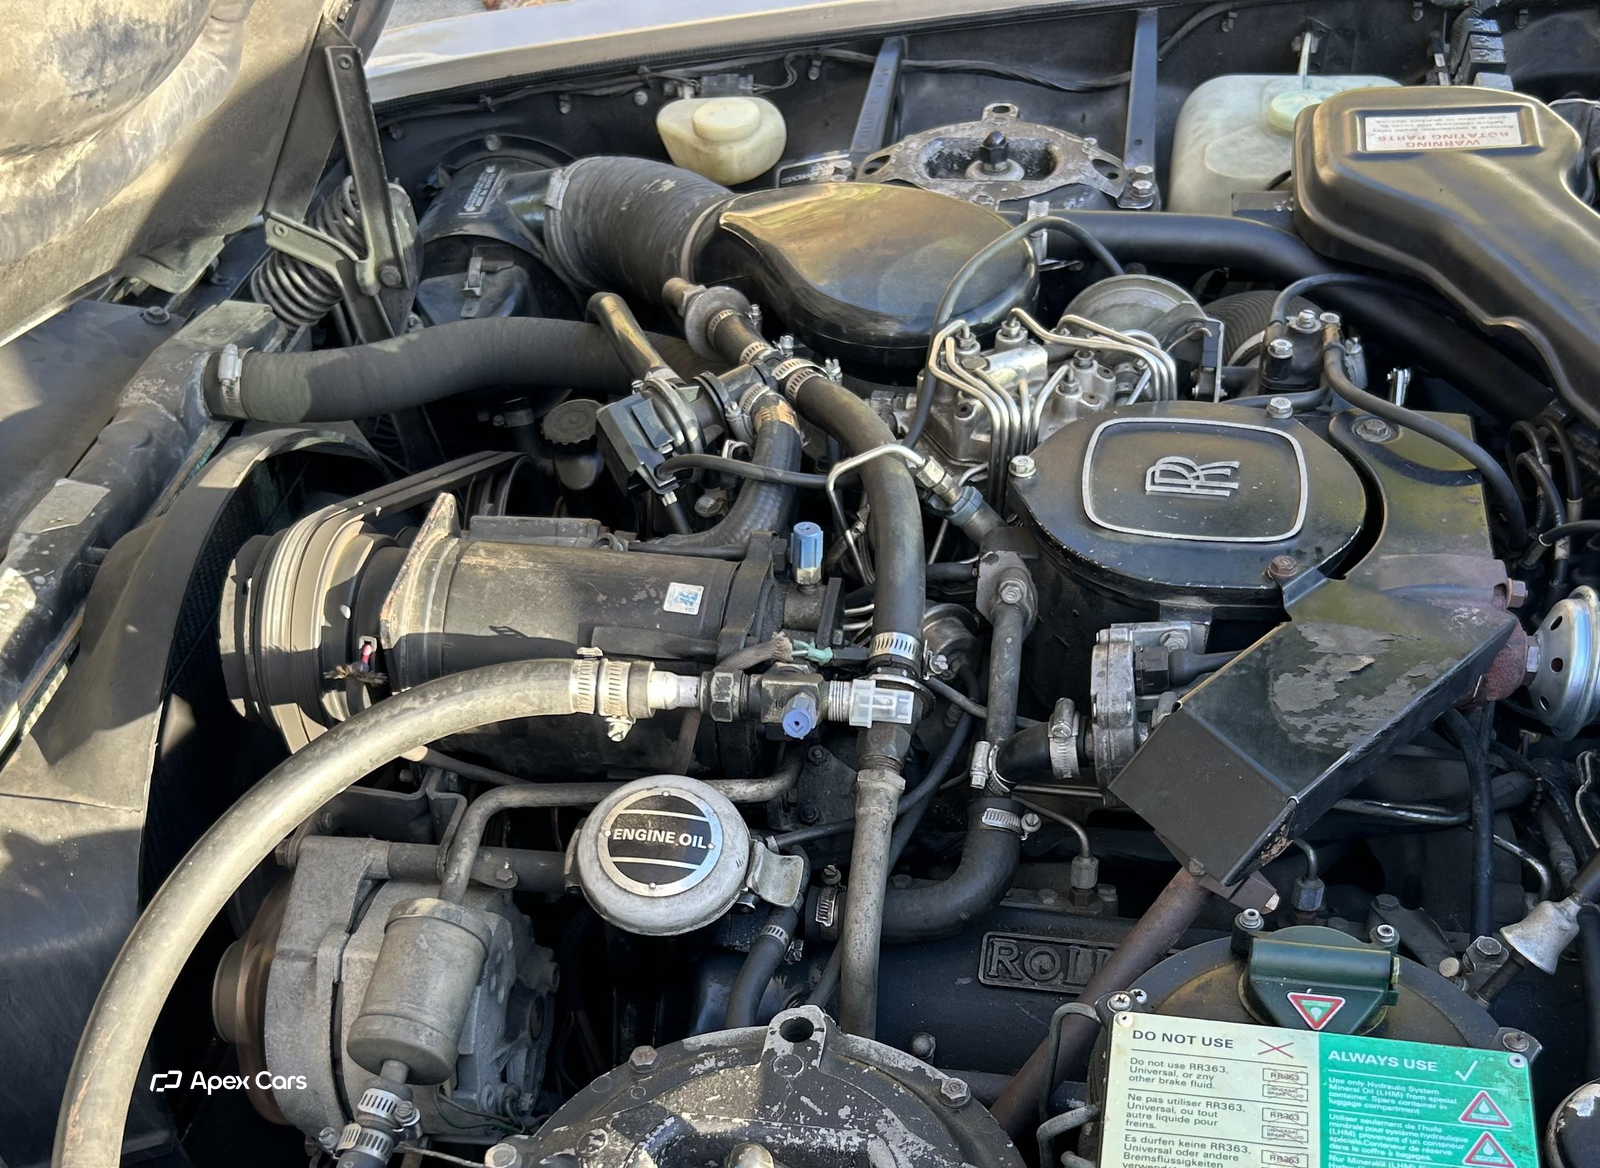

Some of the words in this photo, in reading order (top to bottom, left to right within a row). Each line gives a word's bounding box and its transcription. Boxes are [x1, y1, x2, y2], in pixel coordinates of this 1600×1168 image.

[1378, 134, 1428, 142] PARTS
[1431, 132, 1508, 140] ROTATING
[1406, 139, 1480, 148] WARNING
[612, 828, 676, 844] ENGINE
[679, 834, 707, 849] OIL
[1132, 1030, 1156, 1040] DO
[1162, 1033, 1197, 1045] NOT
[1202, 1037, 1234, 1049] USE
[1130, 1057, 1144, 1065] Do
[1148, 1059, 1164, 1067] not
[1328, 1050, 1399, 1068] ALWAYS
[1403, 1058, 1437, 1072] USE
[1129, 1075, 1155, 1083] other
[1159, 1077, 1186, 1087] brake
[1190, 1079, 1215, 1089] fluid.
[1196, 1073, 1214, 1081] any
[1348, 1078, 1364, 1086] only
[1368, 1081, 1406, 1091] Hydraulic
[1408, 1086, 1439, 1095] System
[1128, 1093, 1142, 1101] Ne
[1167, 1098, 1201, 1107] utiliser
[1329, 1084, 1359, 1093] Mineral
[1376, 1089, 1403, 1099] (LHM)
[1428, 1096, 1457, 1104] special
[1329, 1098, 1362, 1108] luggage
[1364, 1102, 1420, 1114] compartment
[1371, 1095, 1399, 1105] Spare
[1400, 1099, 1437, 1110] container
[1127, 1102, 1177, 1114] Universal,
[1198, 1109, 1218, 1118] tout
[1126, 1119, 1156, 1129] freins.
[1156, 1114, 1190, 1123] liquide
[1194, 1118, 1218, 1126] pour
[1329, 1114, 1358, 1122] Utiliser
[1360, 1118, 1402, 1128] seulement
[1329, 1121, 1364, 1131] minérale
[1420, 1132, 1468, 1143] hydraulique
[1329, 1128, 1356, 1138] (LHM)
[1359, 1132, 1400, 1143] provenant
[1422, 1140, 1465, 1150] conteneur
[1124, 1134, 1136, 1142] Es
[1178, 1139, 1206, 1149] keine
[1124, 1143, 1172, 1154] Universal
[1176, 1148, 1199, 1157] oder
[1203, 1151, 1239, 1161] andere
[1329, 1143, 1349, 1151] dans
[1362, 1147, 1386, 1156] coffre
[1422, 1147, 1452, 1156] réserve
[1328, 1154, 1344, 1163] Nur
